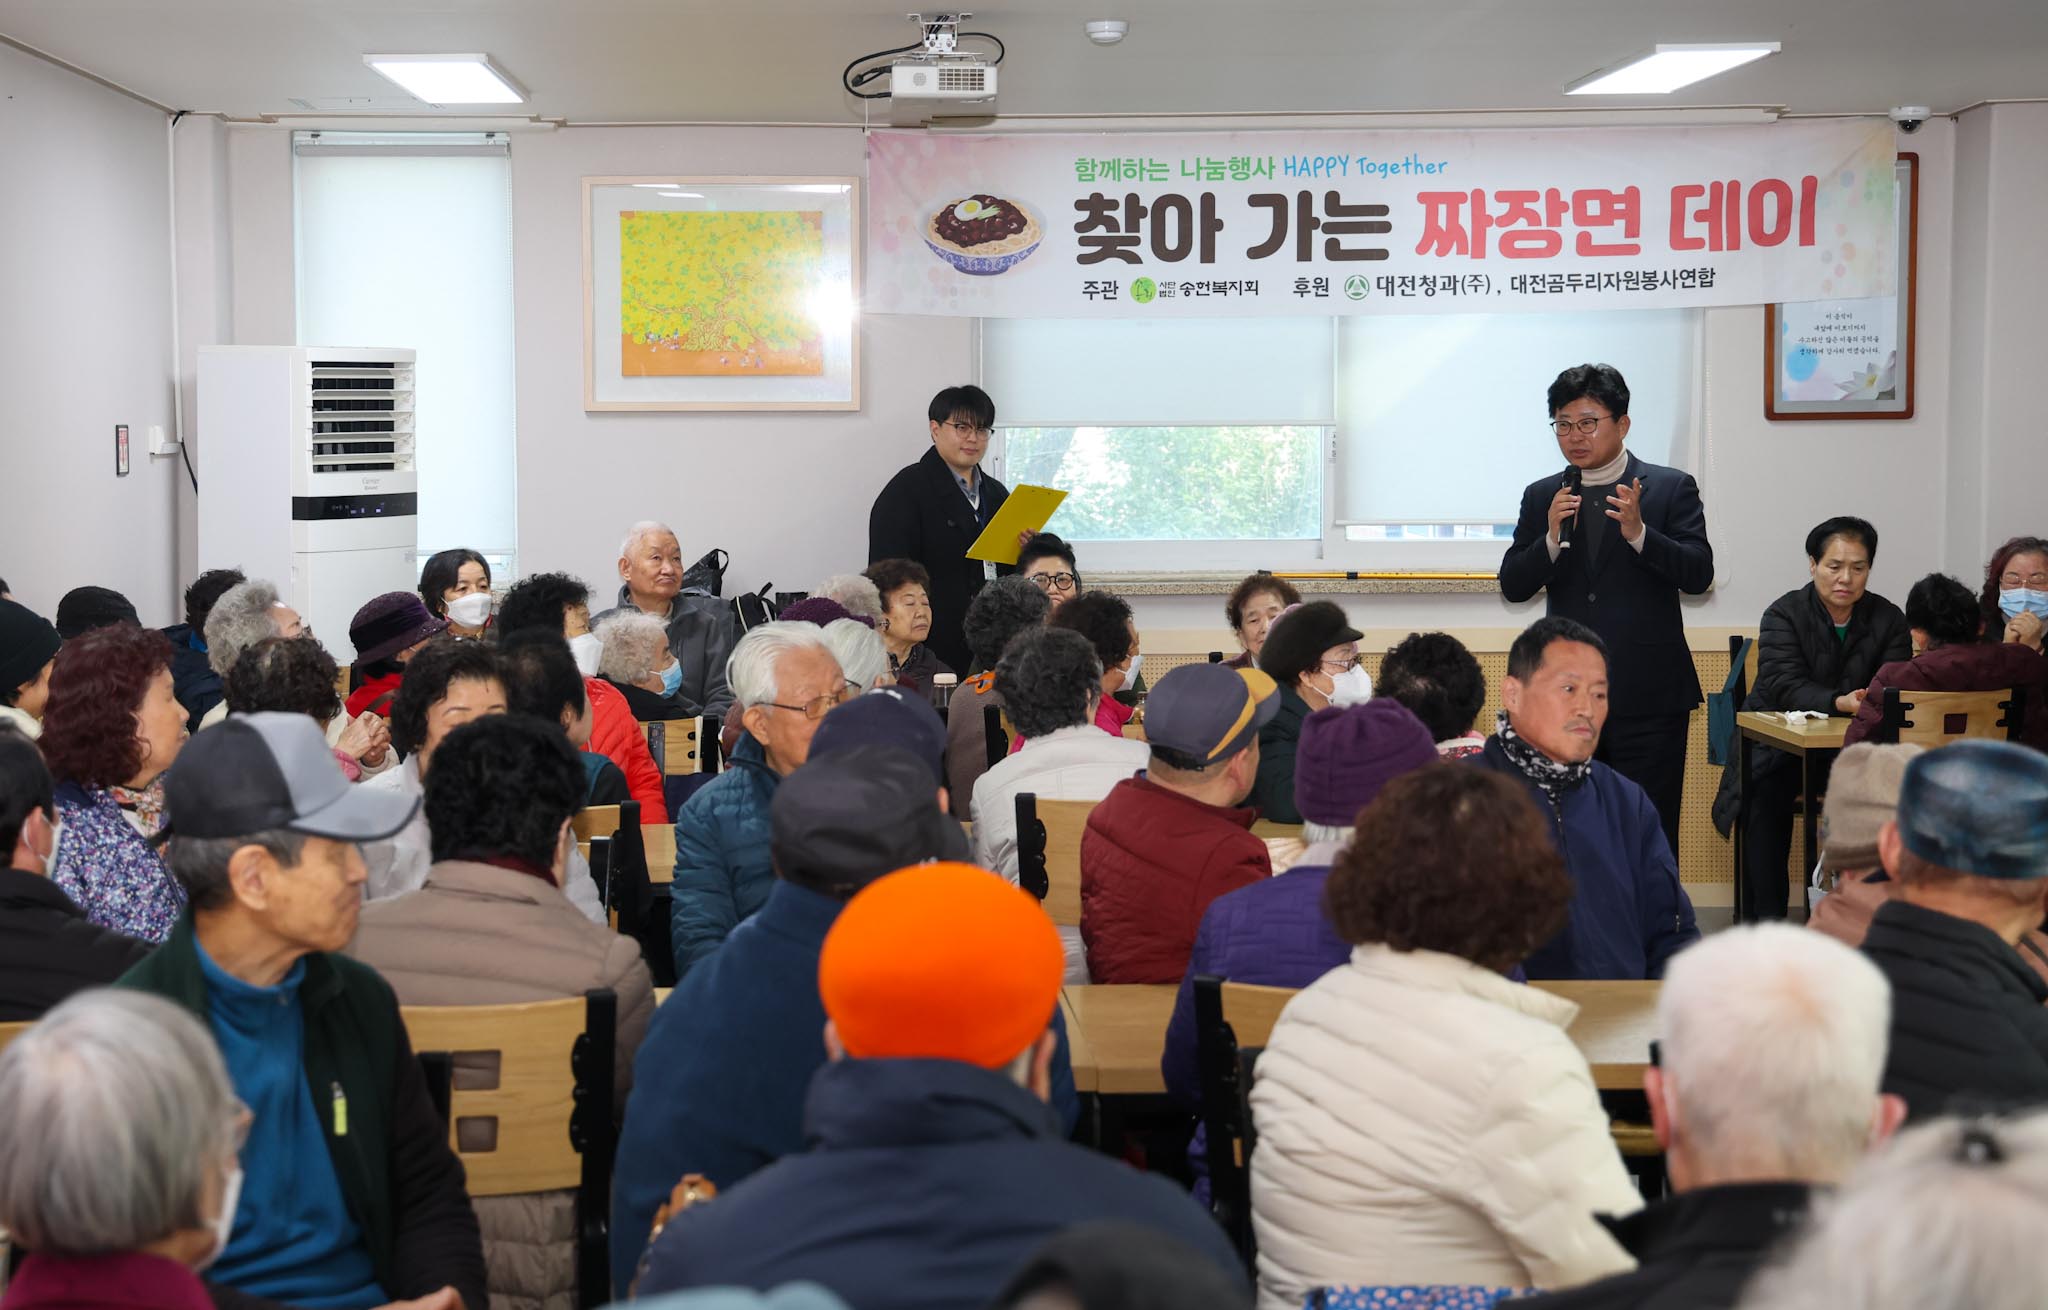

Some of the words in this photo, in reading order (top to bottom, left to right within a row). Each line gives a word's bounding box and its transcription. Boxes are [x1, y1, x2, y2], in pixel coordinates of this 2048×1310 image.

[1074, 157, 1170, 183] 함께하는
[1180, 156, 1276, 182] 나눔행사
[1283, 154, 1350, 179] HAPPY
[1355, 152, 1448, 179] Together
[1074, 191, 1224, 265] 찾아
[1246, 190, 1393, 263] 가는
[1414, 186, 1642, 260] 짜장면
[1668, 175, 1818, 252] 데이
[1082, 280, 1119, 301] 주관
[1179, 279, 1259, 298] 송헌복지회
[1292, 276, 1330, 298] 후원
[1510, 267, 1716, 296] 대전곰두리자원봉사연합
